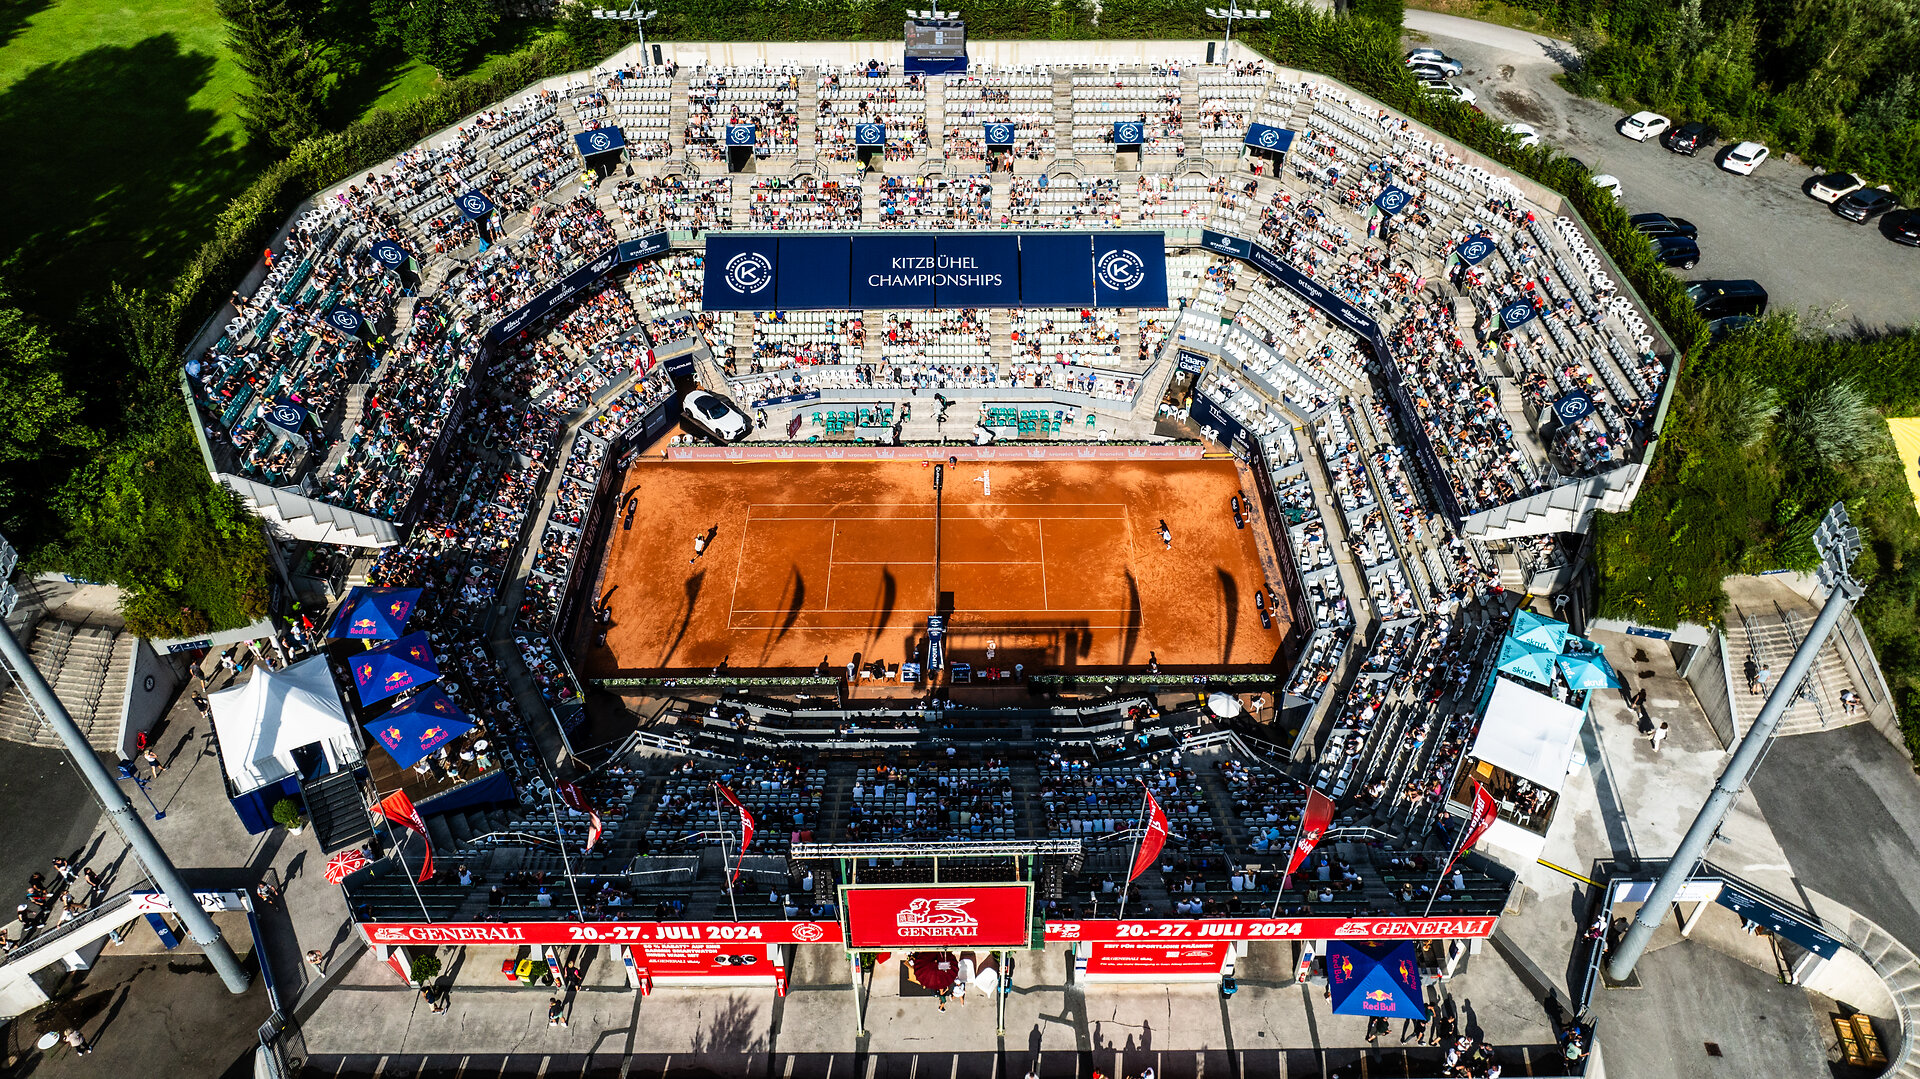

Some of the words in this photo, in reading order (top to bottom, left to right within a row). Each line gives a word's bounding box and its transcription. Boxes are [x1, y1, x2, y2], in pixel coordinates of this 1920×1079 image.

[892, 254, 978, 269] KITZBÜHEL
[868, 274, 1003, 287] CHAMPIONSHIPS
[350, 627, 363, 635] Red
[363, 627, 377, 635] Bull
[384, 681, 400, 692] Red
[399, 676, 413, 688] Bull
[420, 740, 436, 751] Red
[434, 730, 449, 742] Bull
[408, 927, 525, 941] GENERALI
[569, 926, 650, 940] 20.-27.
[655, 926, 700, 940] JULI
[705, 926, 762, 940] 2024
[897, 927, 978, 937] GENERALI
[1116, 924, 1191, 937] 20.-27.
[1198, 923, 1243, 936] JULI
[1247, 922, 1303, 936] 2024
[1372, 920, 1489, 936] GENERALI
[1332, 954, 1341, 968] Red
[1334, 969, 1344, 984] Bull
[1363, 1001, 1379, 1011] Red
[1379, 1001, 1396, 1012] Bull
